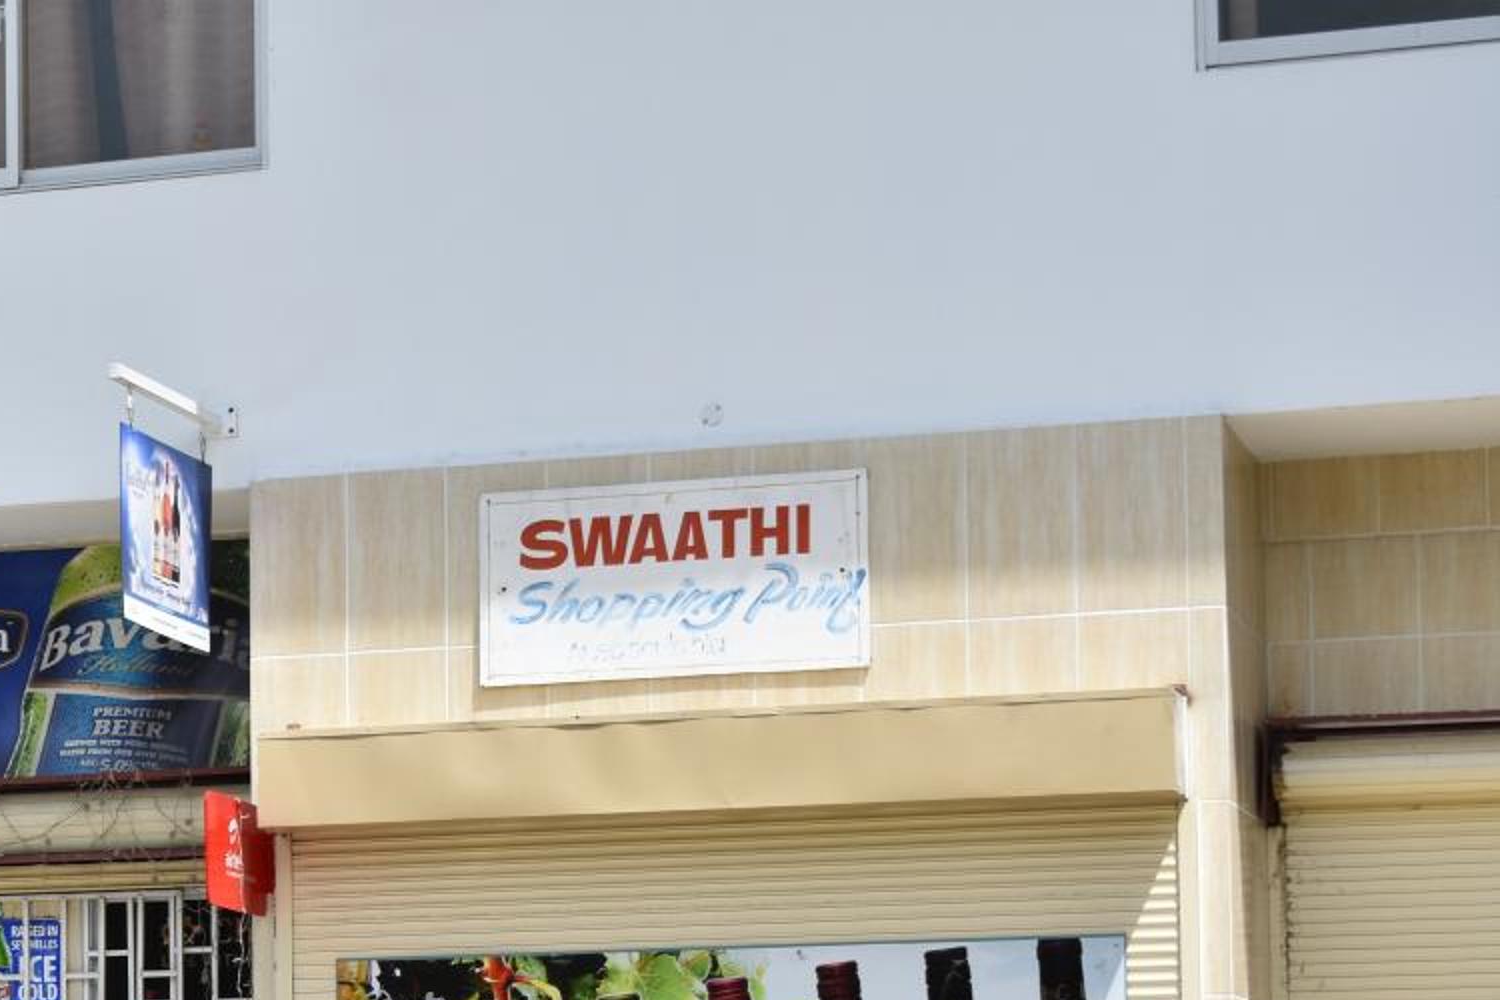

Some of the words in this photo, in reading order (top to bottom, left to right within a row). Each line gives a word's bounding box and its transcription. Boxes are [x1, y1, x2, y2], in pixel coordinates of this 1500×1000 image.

[519, 503, 811, 571] SWAATHI
[509, 577, 746, 632] Shopping
[39, 615, 250, 673] Bavai
[91, 718, 165, 739] BEER
[93, 705, 173, 721] PREMIUM
[18, 955, 58, 983] ICE
